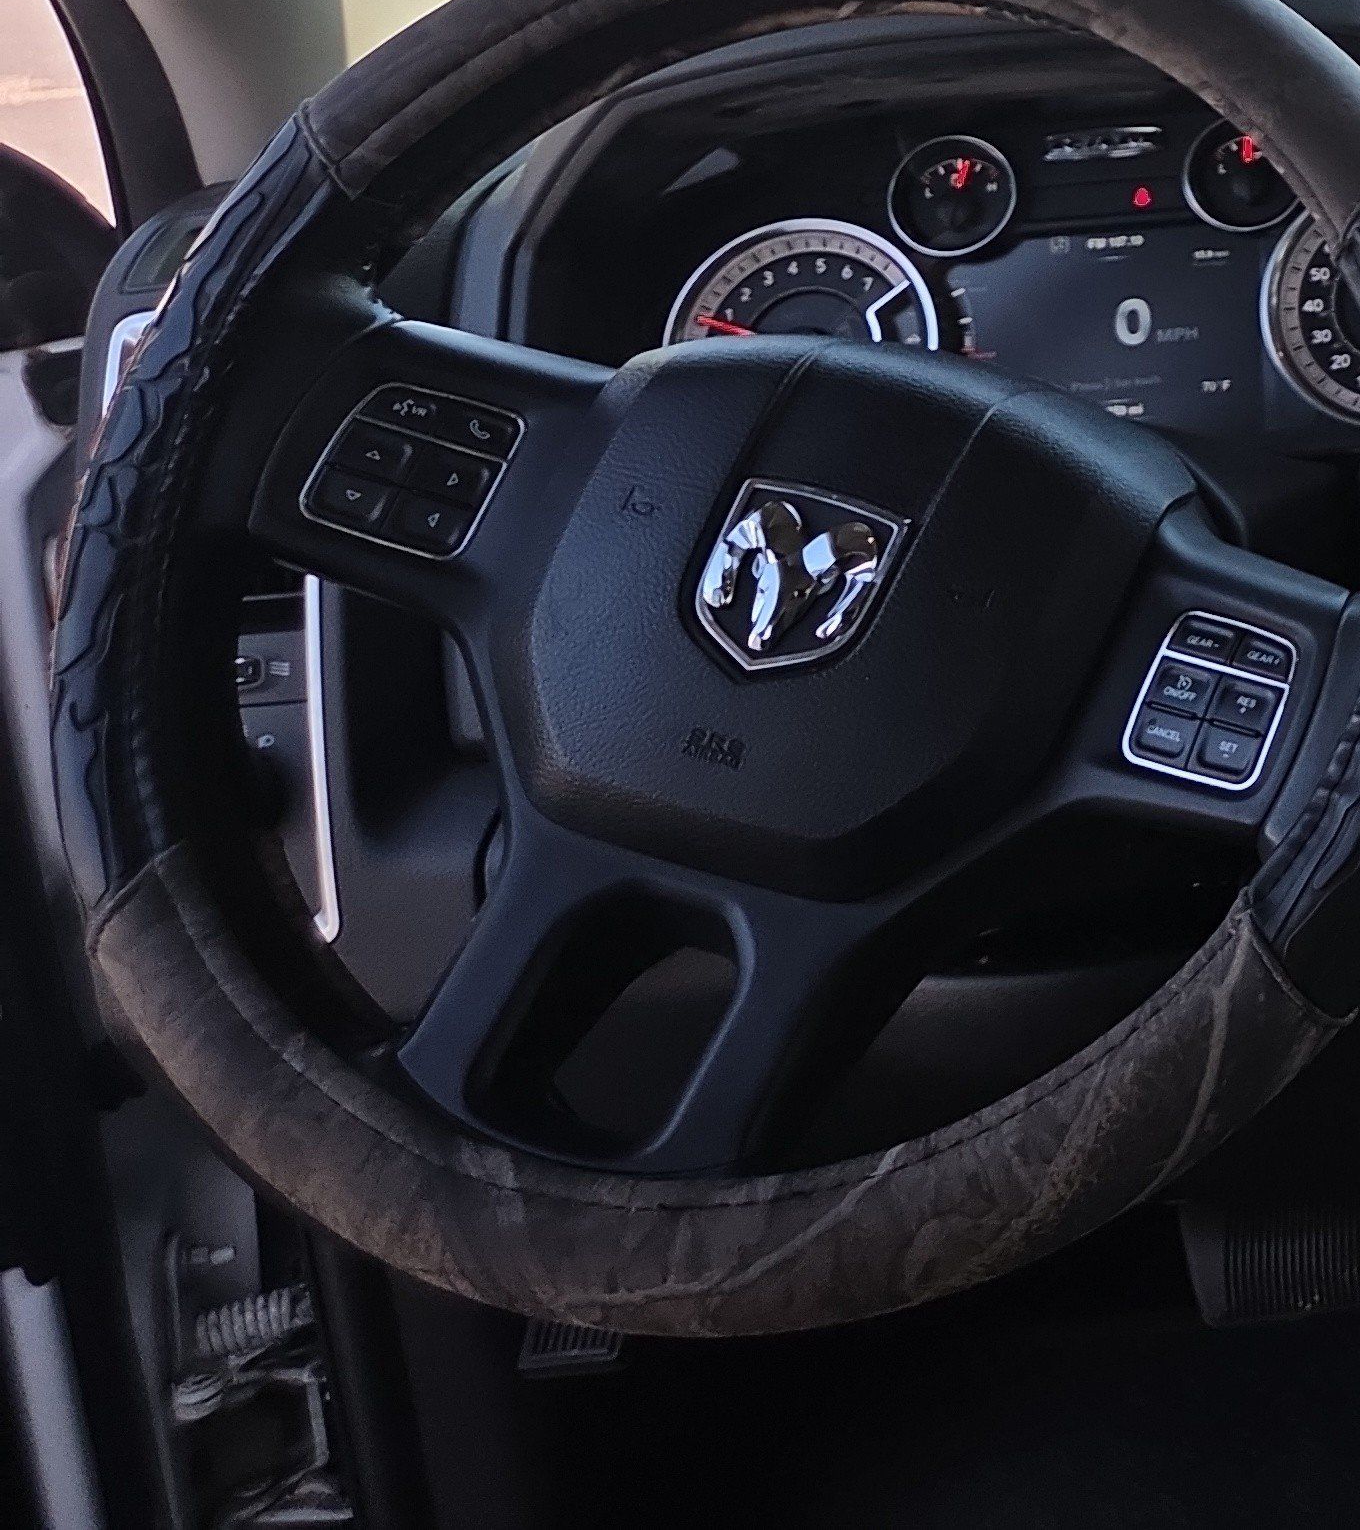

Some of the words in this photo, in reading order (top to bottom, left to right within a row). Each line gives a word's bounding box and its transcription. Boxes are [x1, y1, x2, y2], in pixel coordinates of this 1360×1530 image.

[786, 260, 800, 276] 4
[814, 257, 828, 274] 5
[841, 264, 854, 280] 6
[762, 270, 775, 288] 3
[1308, 267, 1331, 282] 50
[863, 276, 875, 292] 7
[740, 287, 753, 304] 2
[1302, 298, 1325, 313] 40
[1115, 297, 1152, 346] 0
[1310, 329, 1333, 343] 30
[1330, 353, 1351, 369] 20
[1146, 724, 1181, 742] CANCEL
[1218, 740, 1238, 754] SET
